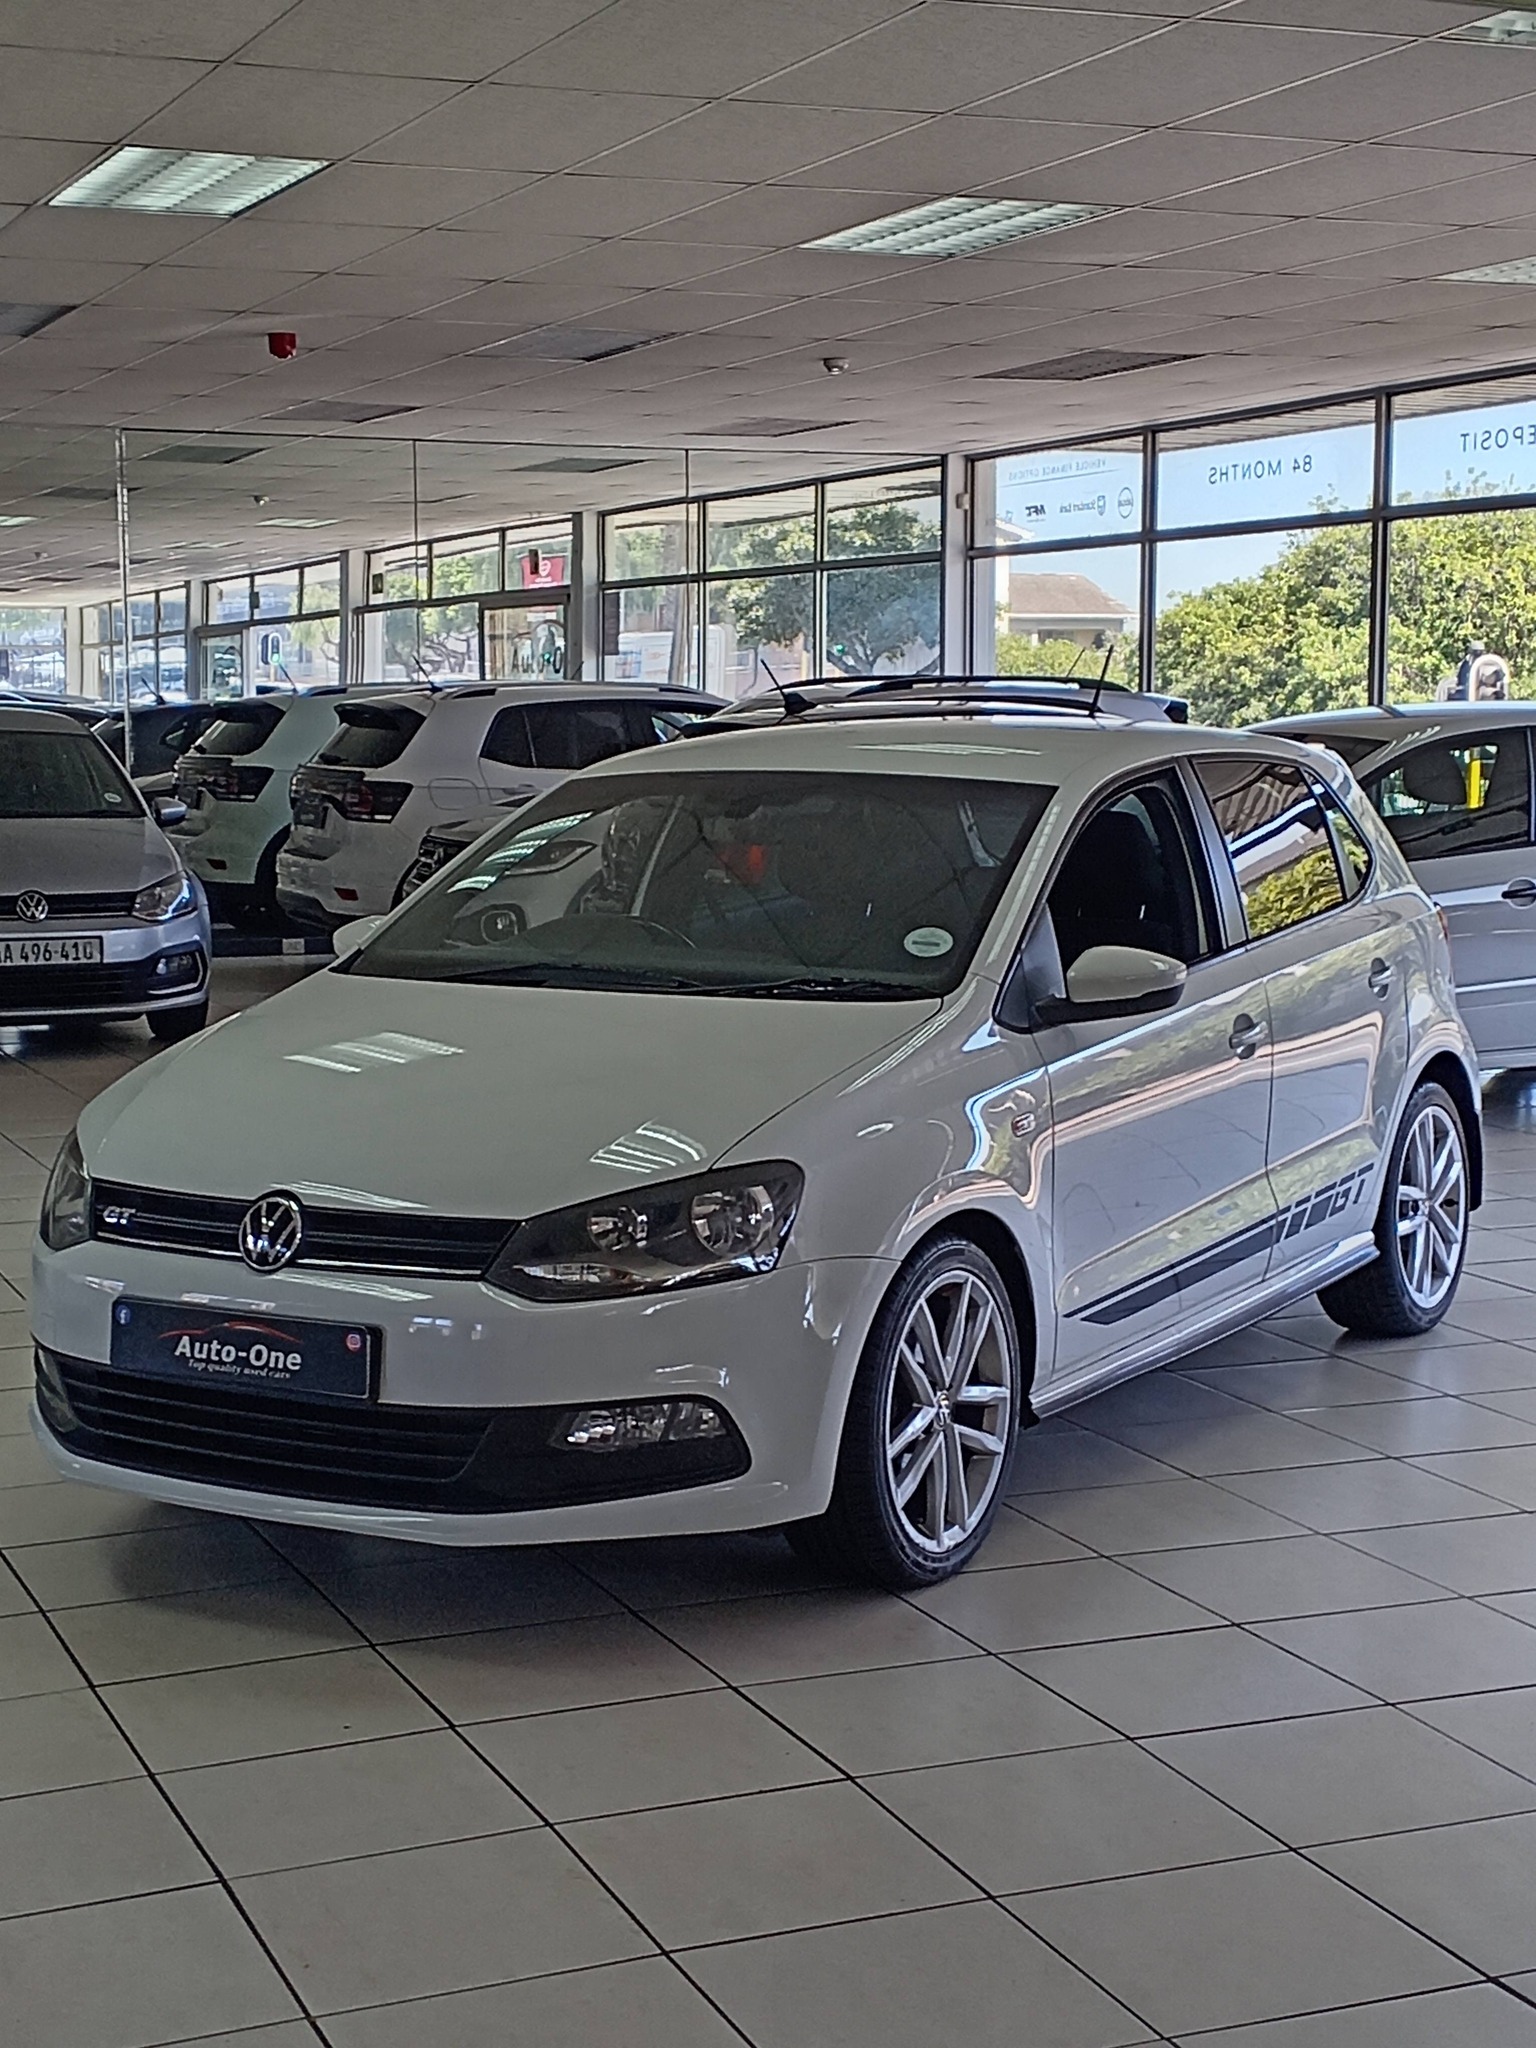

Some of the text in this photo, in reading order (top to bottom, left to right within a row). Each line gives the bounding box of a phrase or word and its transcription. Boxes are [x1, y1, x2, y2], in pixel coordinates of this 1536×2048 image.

[103, 1205, 136, 1224] GT
[174, 1335, 302, 1371] Auto-One
[188, 1358, 291, 1379] Top quality used cars
